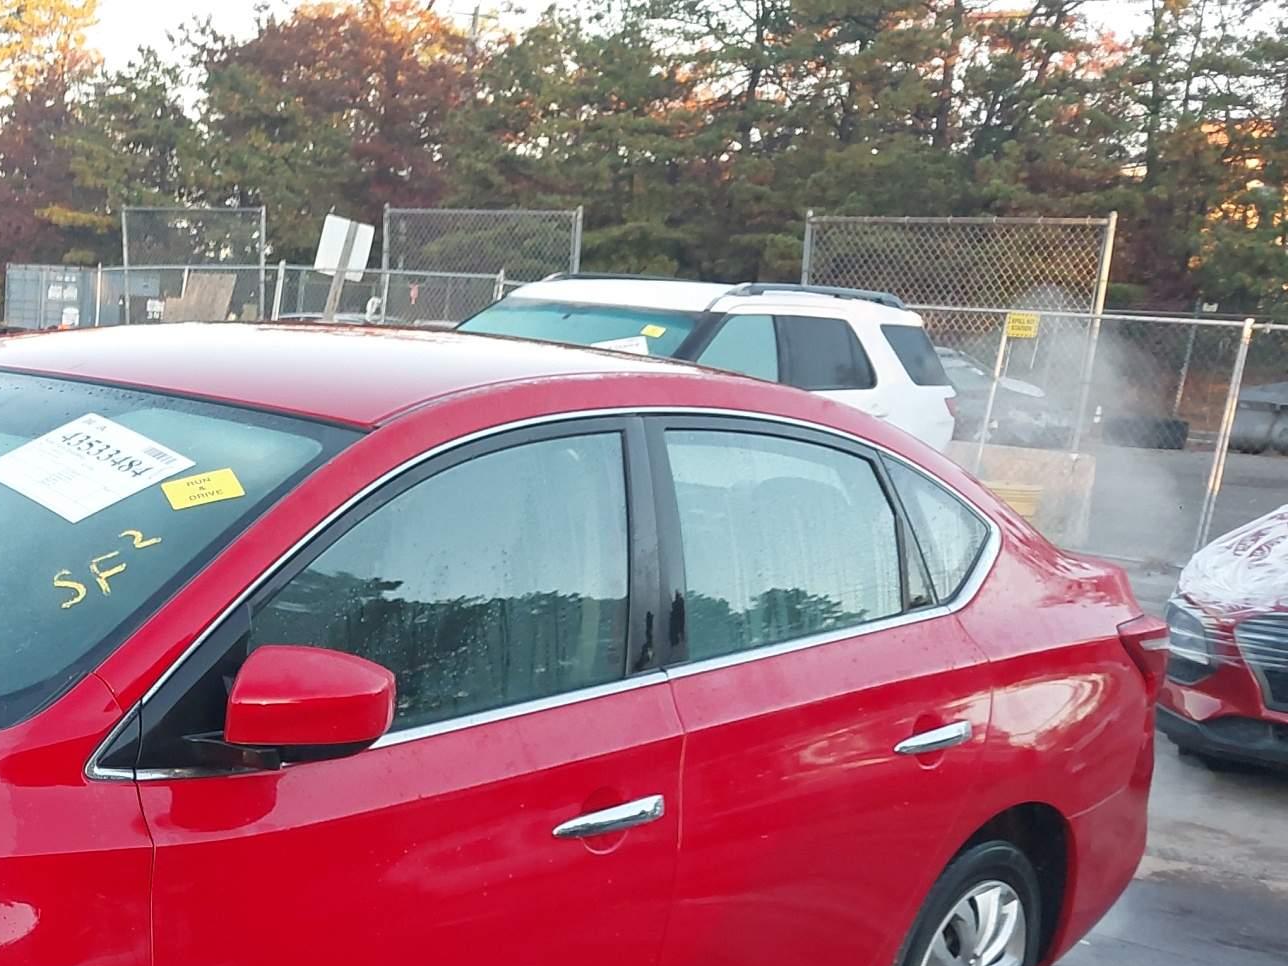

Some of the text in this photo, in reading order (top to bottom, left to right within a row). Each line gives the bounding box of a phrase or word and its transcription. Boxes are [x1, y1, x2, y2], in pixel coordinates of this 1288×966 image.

[62, 432, 153, 478] 43533484
[186, 477, 212, 487] RUN
[189, 488, 225, 501] DRIVE
